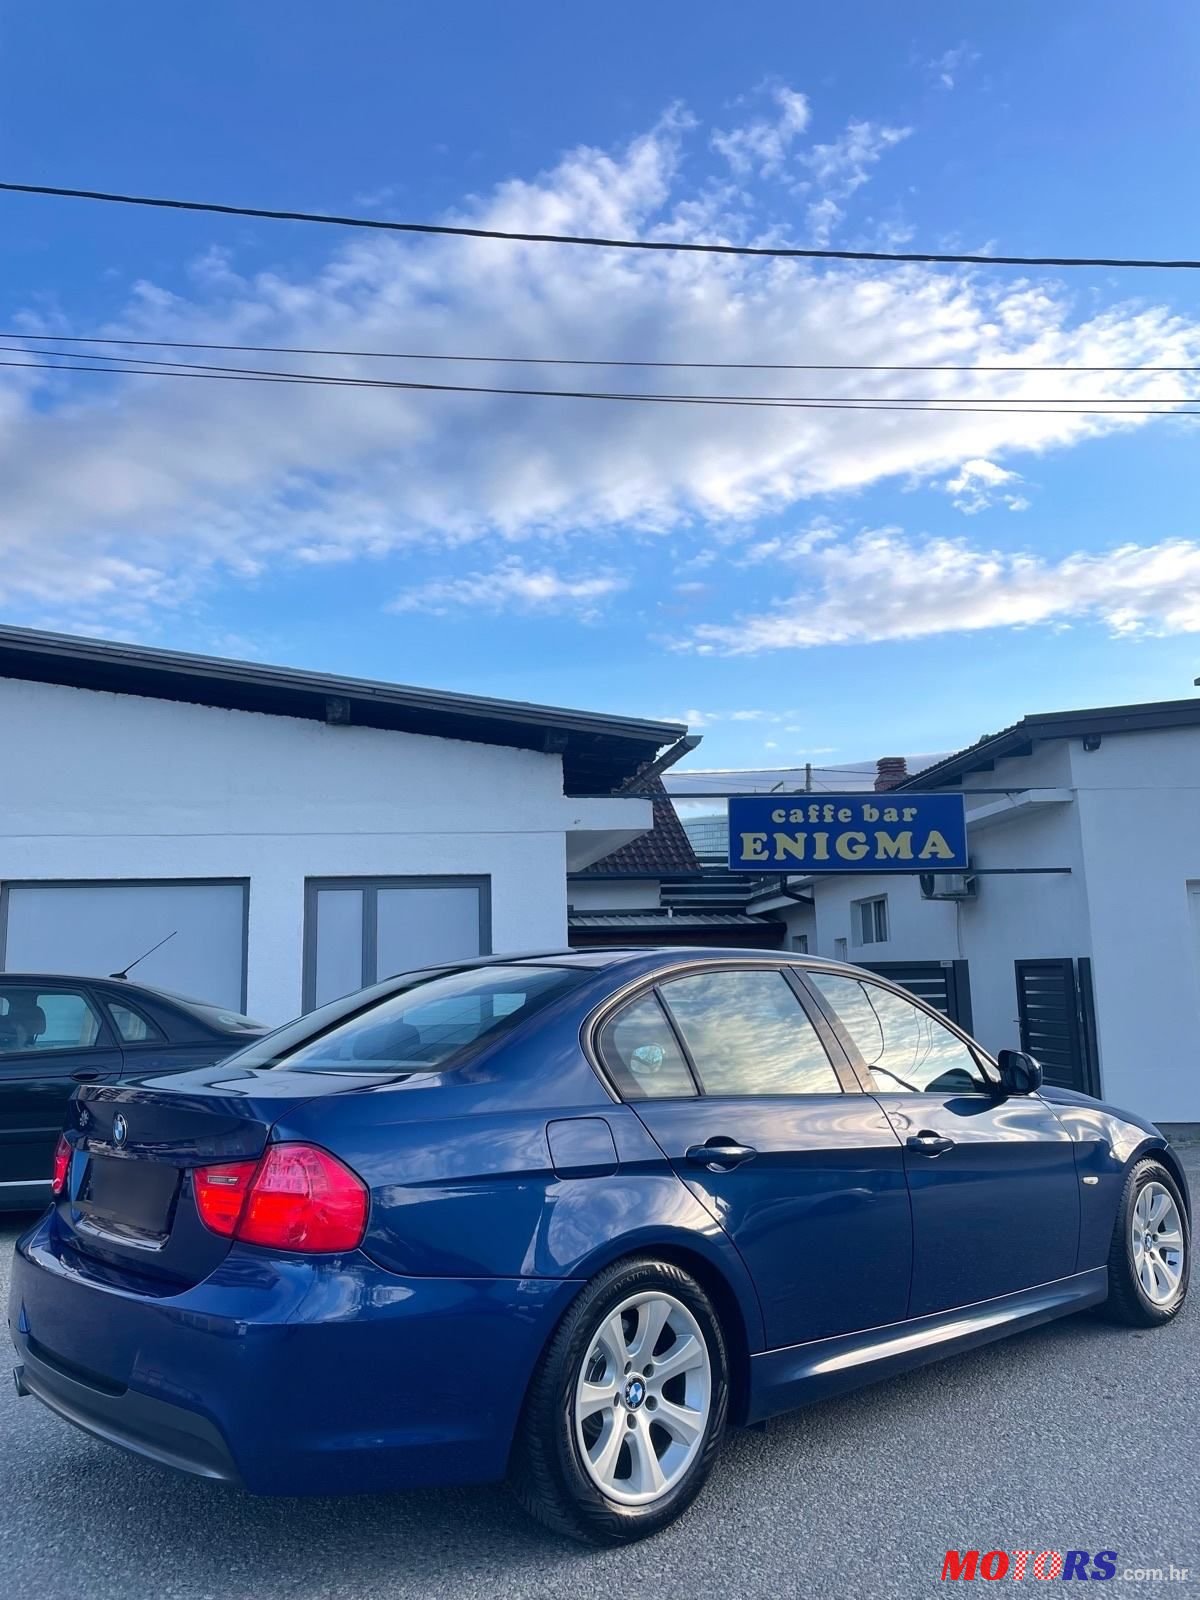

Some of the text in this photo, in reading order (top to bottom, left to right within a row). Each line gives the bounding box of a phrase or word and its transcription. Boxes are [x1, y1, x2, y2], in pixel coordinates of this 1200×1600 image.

[772, 804, 917, 823] caffe bar
[740, 831, 955, 861] ENIGMA
